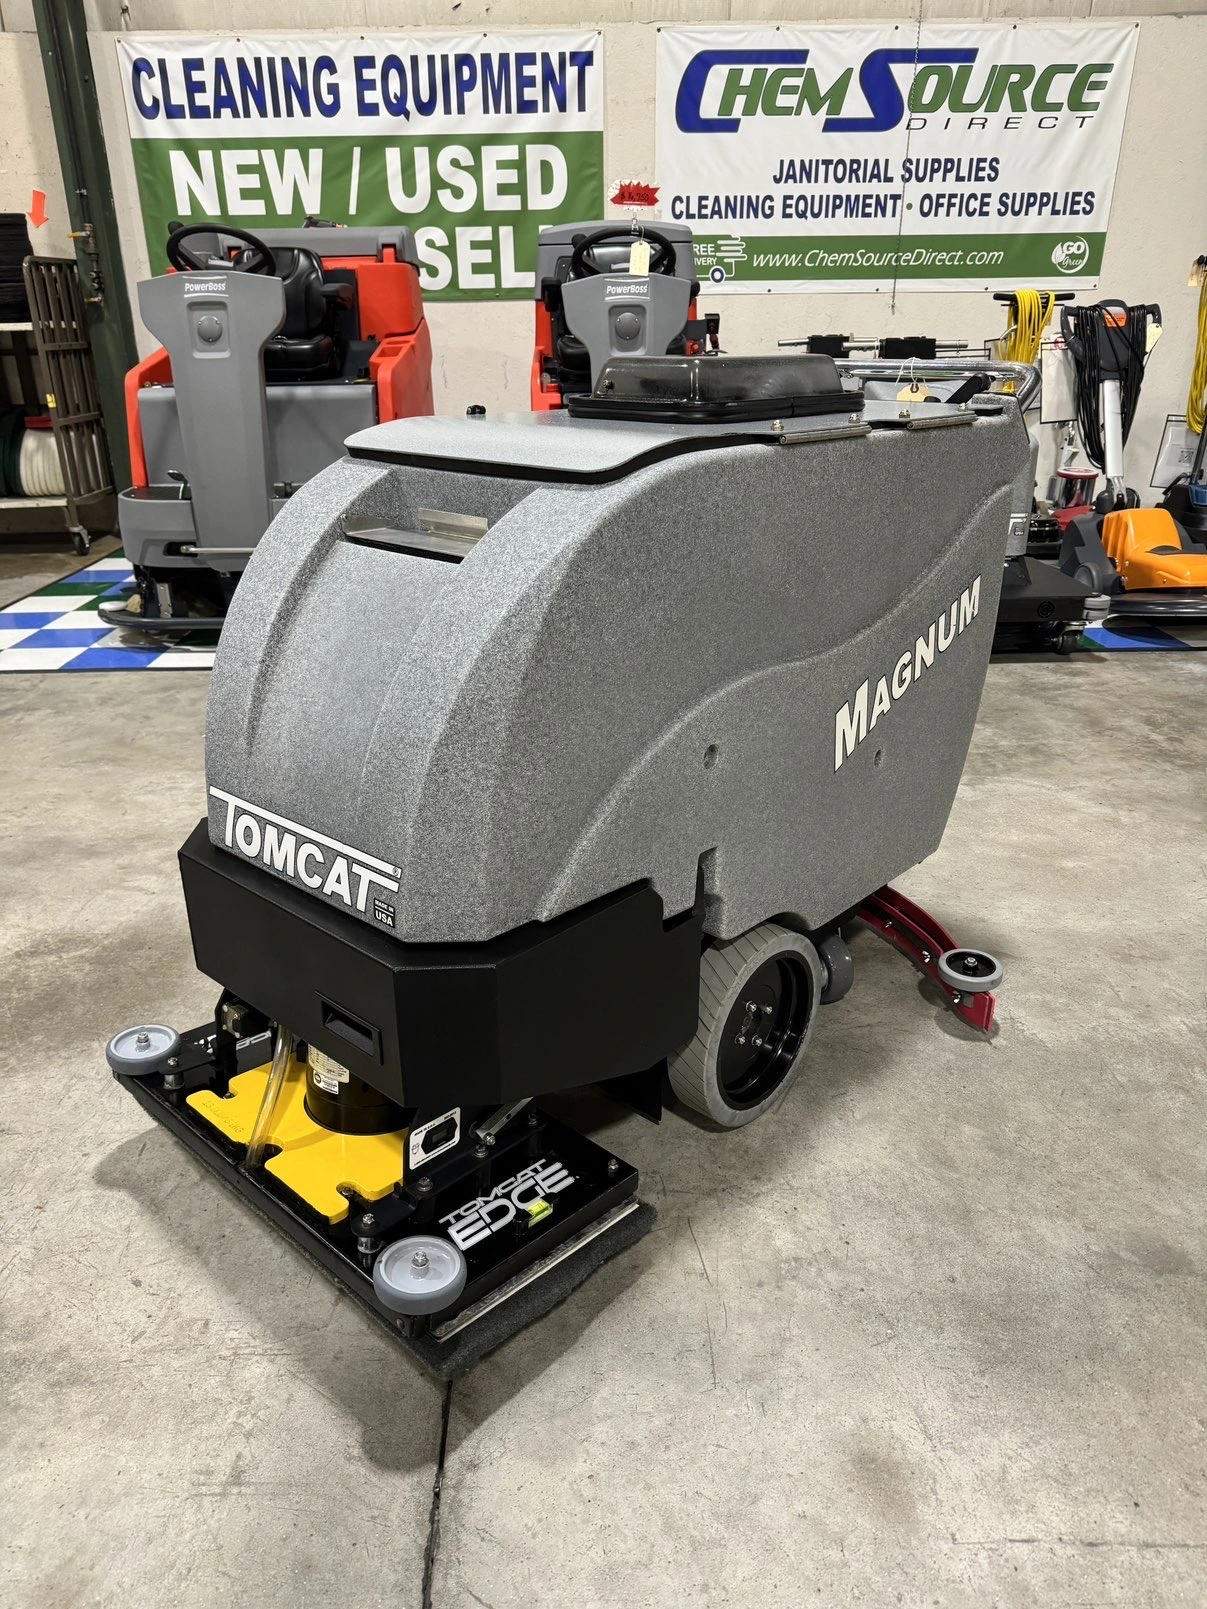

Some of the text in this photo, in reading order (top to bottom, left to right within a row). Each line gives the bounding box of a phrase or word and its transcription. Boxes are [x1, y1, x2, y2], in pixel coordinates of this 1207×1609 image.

[132, 50, 594, 122] CLEANING EQUIPMENT
[906, 115, 1094, 131] DIRECT
[169, 144, 568, 216] NEW / USED
[773, 157, 1000, 184] JANITORIAL SUPPLIES
[671, 191, 1096, 221] CLEANING EQUIPMENT OFFICE SUPPLIES
[414, 225, 553, 290] SEL
[693, 244, 715, 255] REE
[752, 248, 1004, 267] www.ChemSourceDirect.com
[1063, 241, 1085, 254] GO
[184, 282, 226, 291] PowerBoss
[606, 284, 648, 294] PowerBoss
[834, 573, 982, 774] MAGNUM
[209, 785, 402, 913] TOMCAT
[375, 909, 394, 927] USA
[438, 1158, 547, 1224] TOMCAT
[447, 1161, 576, 1251] EDGE
